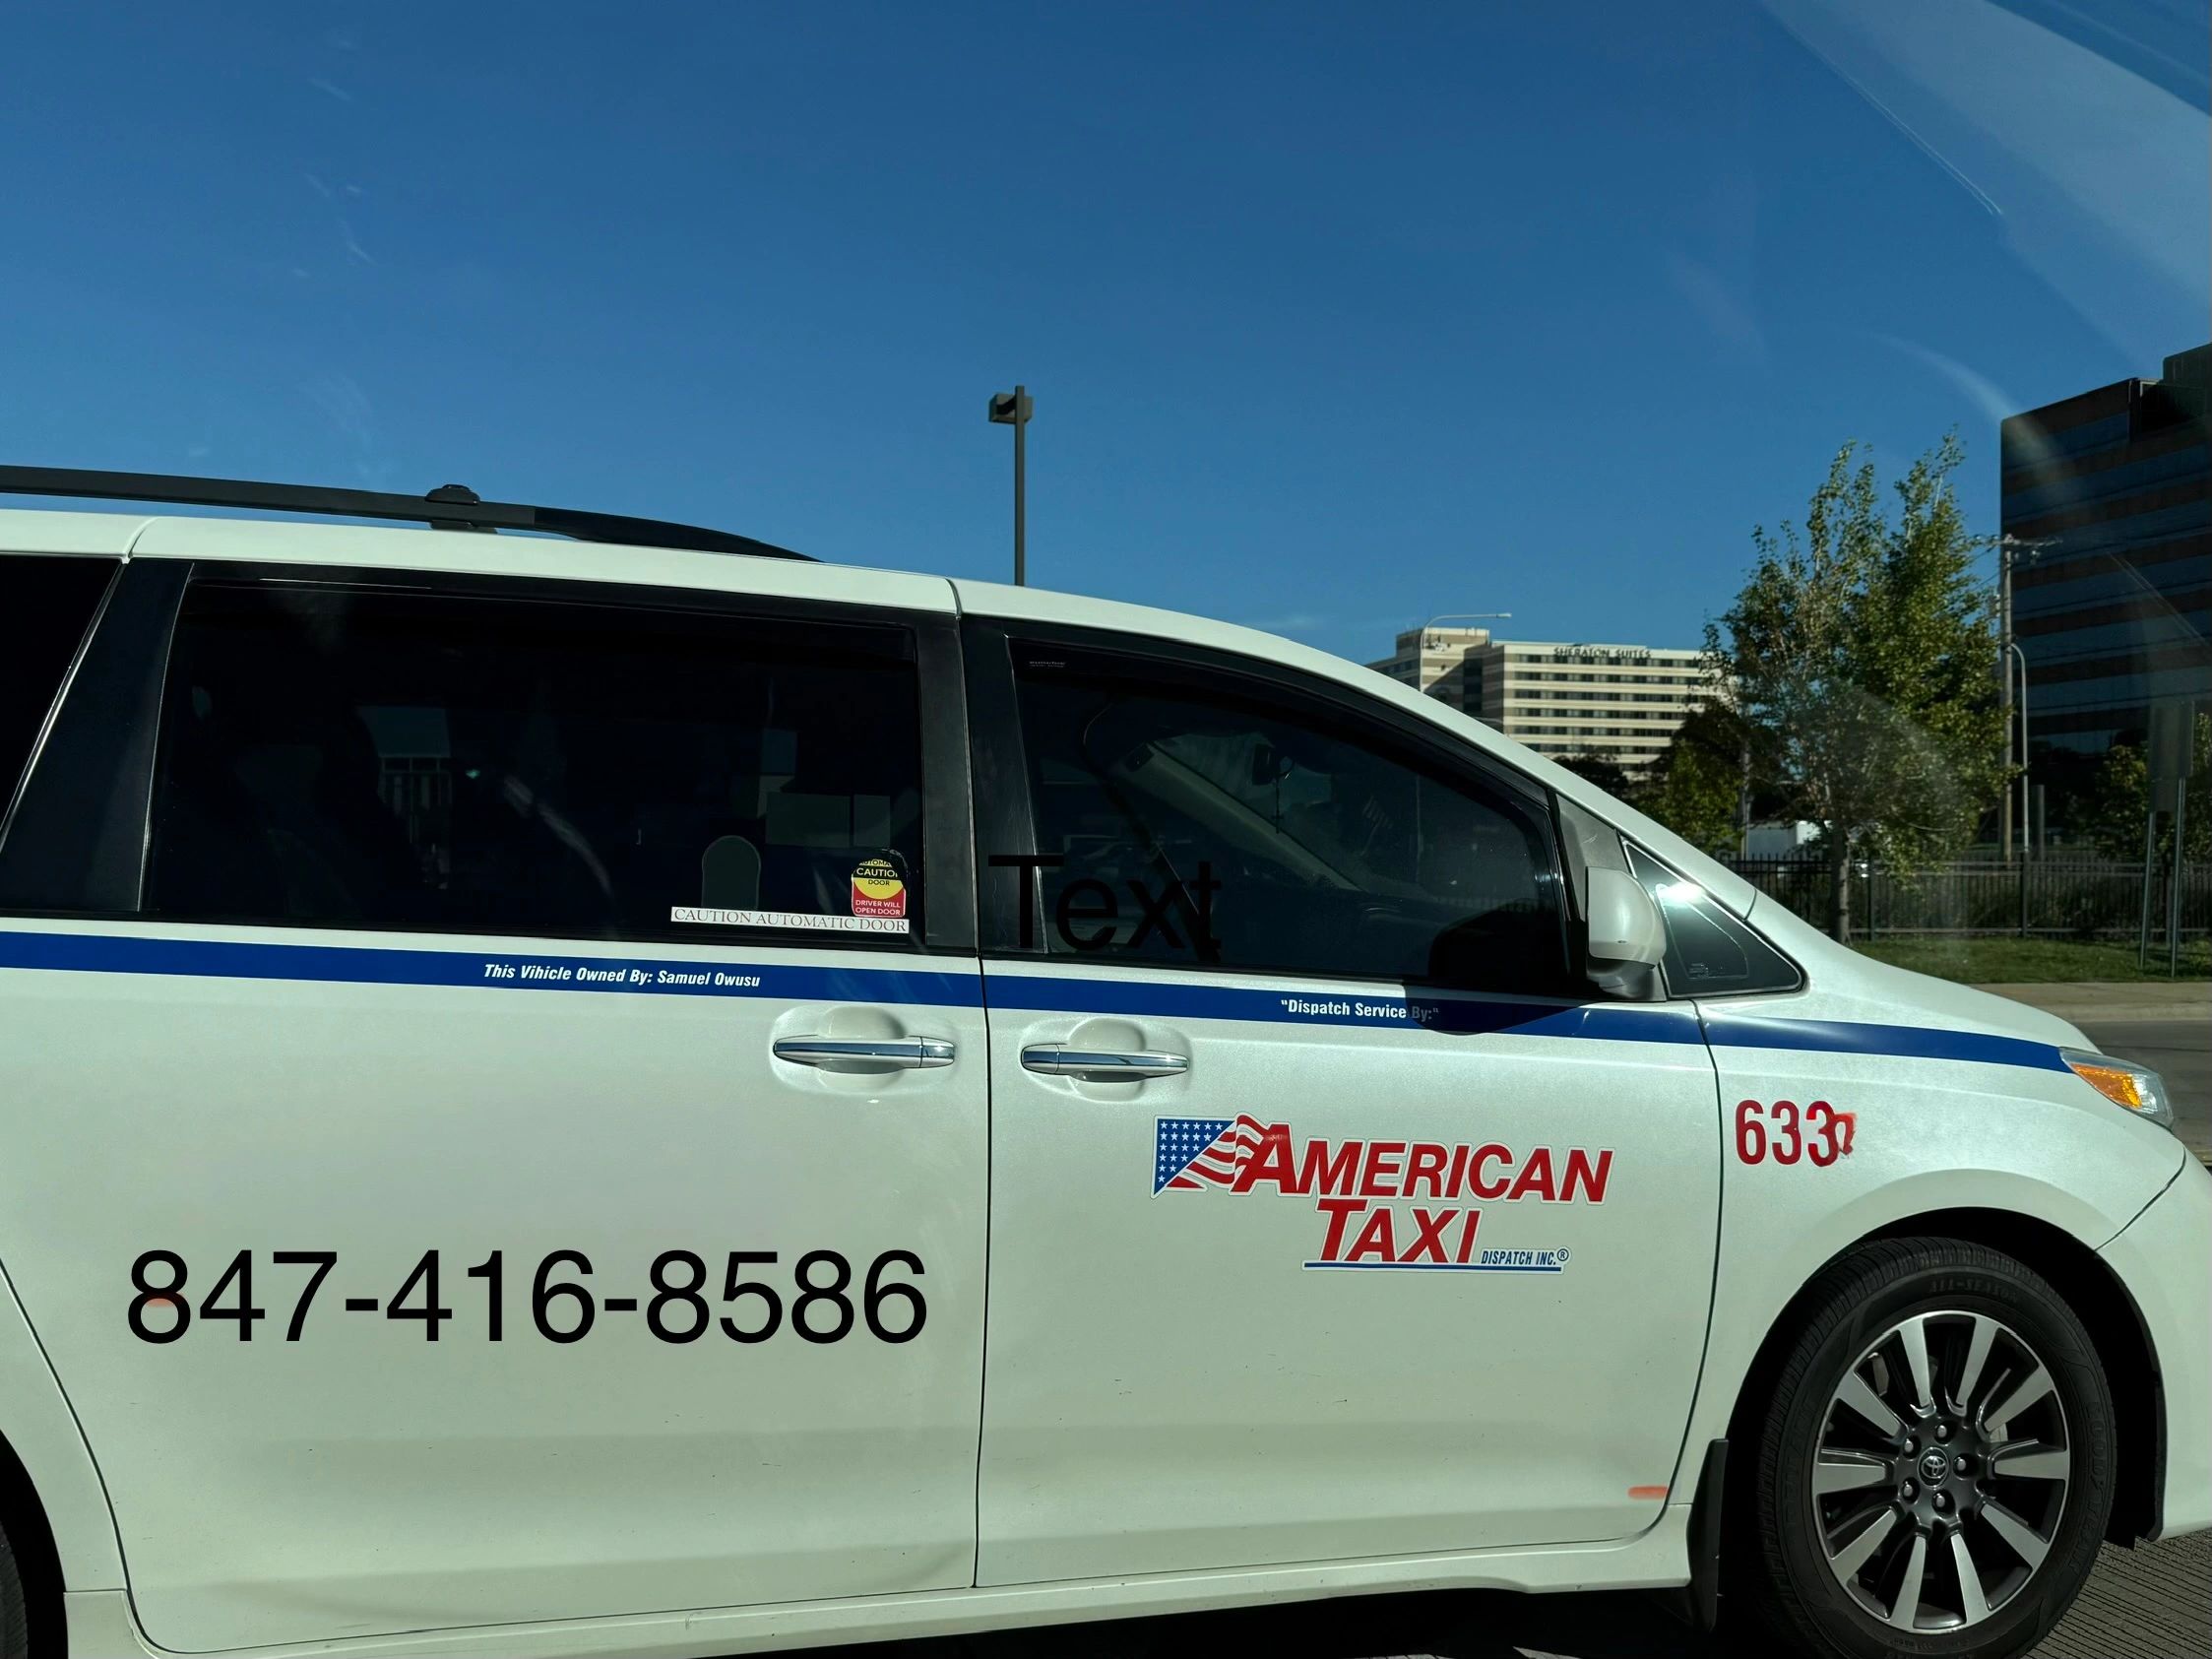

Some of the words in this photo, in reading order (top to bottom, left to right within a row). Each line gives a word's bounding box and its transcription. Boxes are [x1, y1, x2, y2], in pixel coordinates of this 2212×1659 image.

[1553, 647, 1611, 658] SHERATON
[1615, 649, 1651, 659] SUITES
[674, 908, 752, 925] CAUTION
[757, 914, 855, 930] AUTOMATIC
[858, 919, 907, 931] DOOR
[484, 964, 515, 978] This
[521, 965, 571, 981] Vihicle
[576, 967, 625, 983] Owned
[629, 970, 653, 986] By:
[658, 970, 711, 986] Samuel
[715, 972, 761, 988] Owusu
[1281, 999, 1351, 1015] "Dispatch
[1355, 1002, 1407, 1018] Service
[1228, 1122, 1614, 1203] AMERICAN
[1313, 1198, 1484, 1263] TAXI
[1481, 1250, 1533, 1265] DISPATCH
